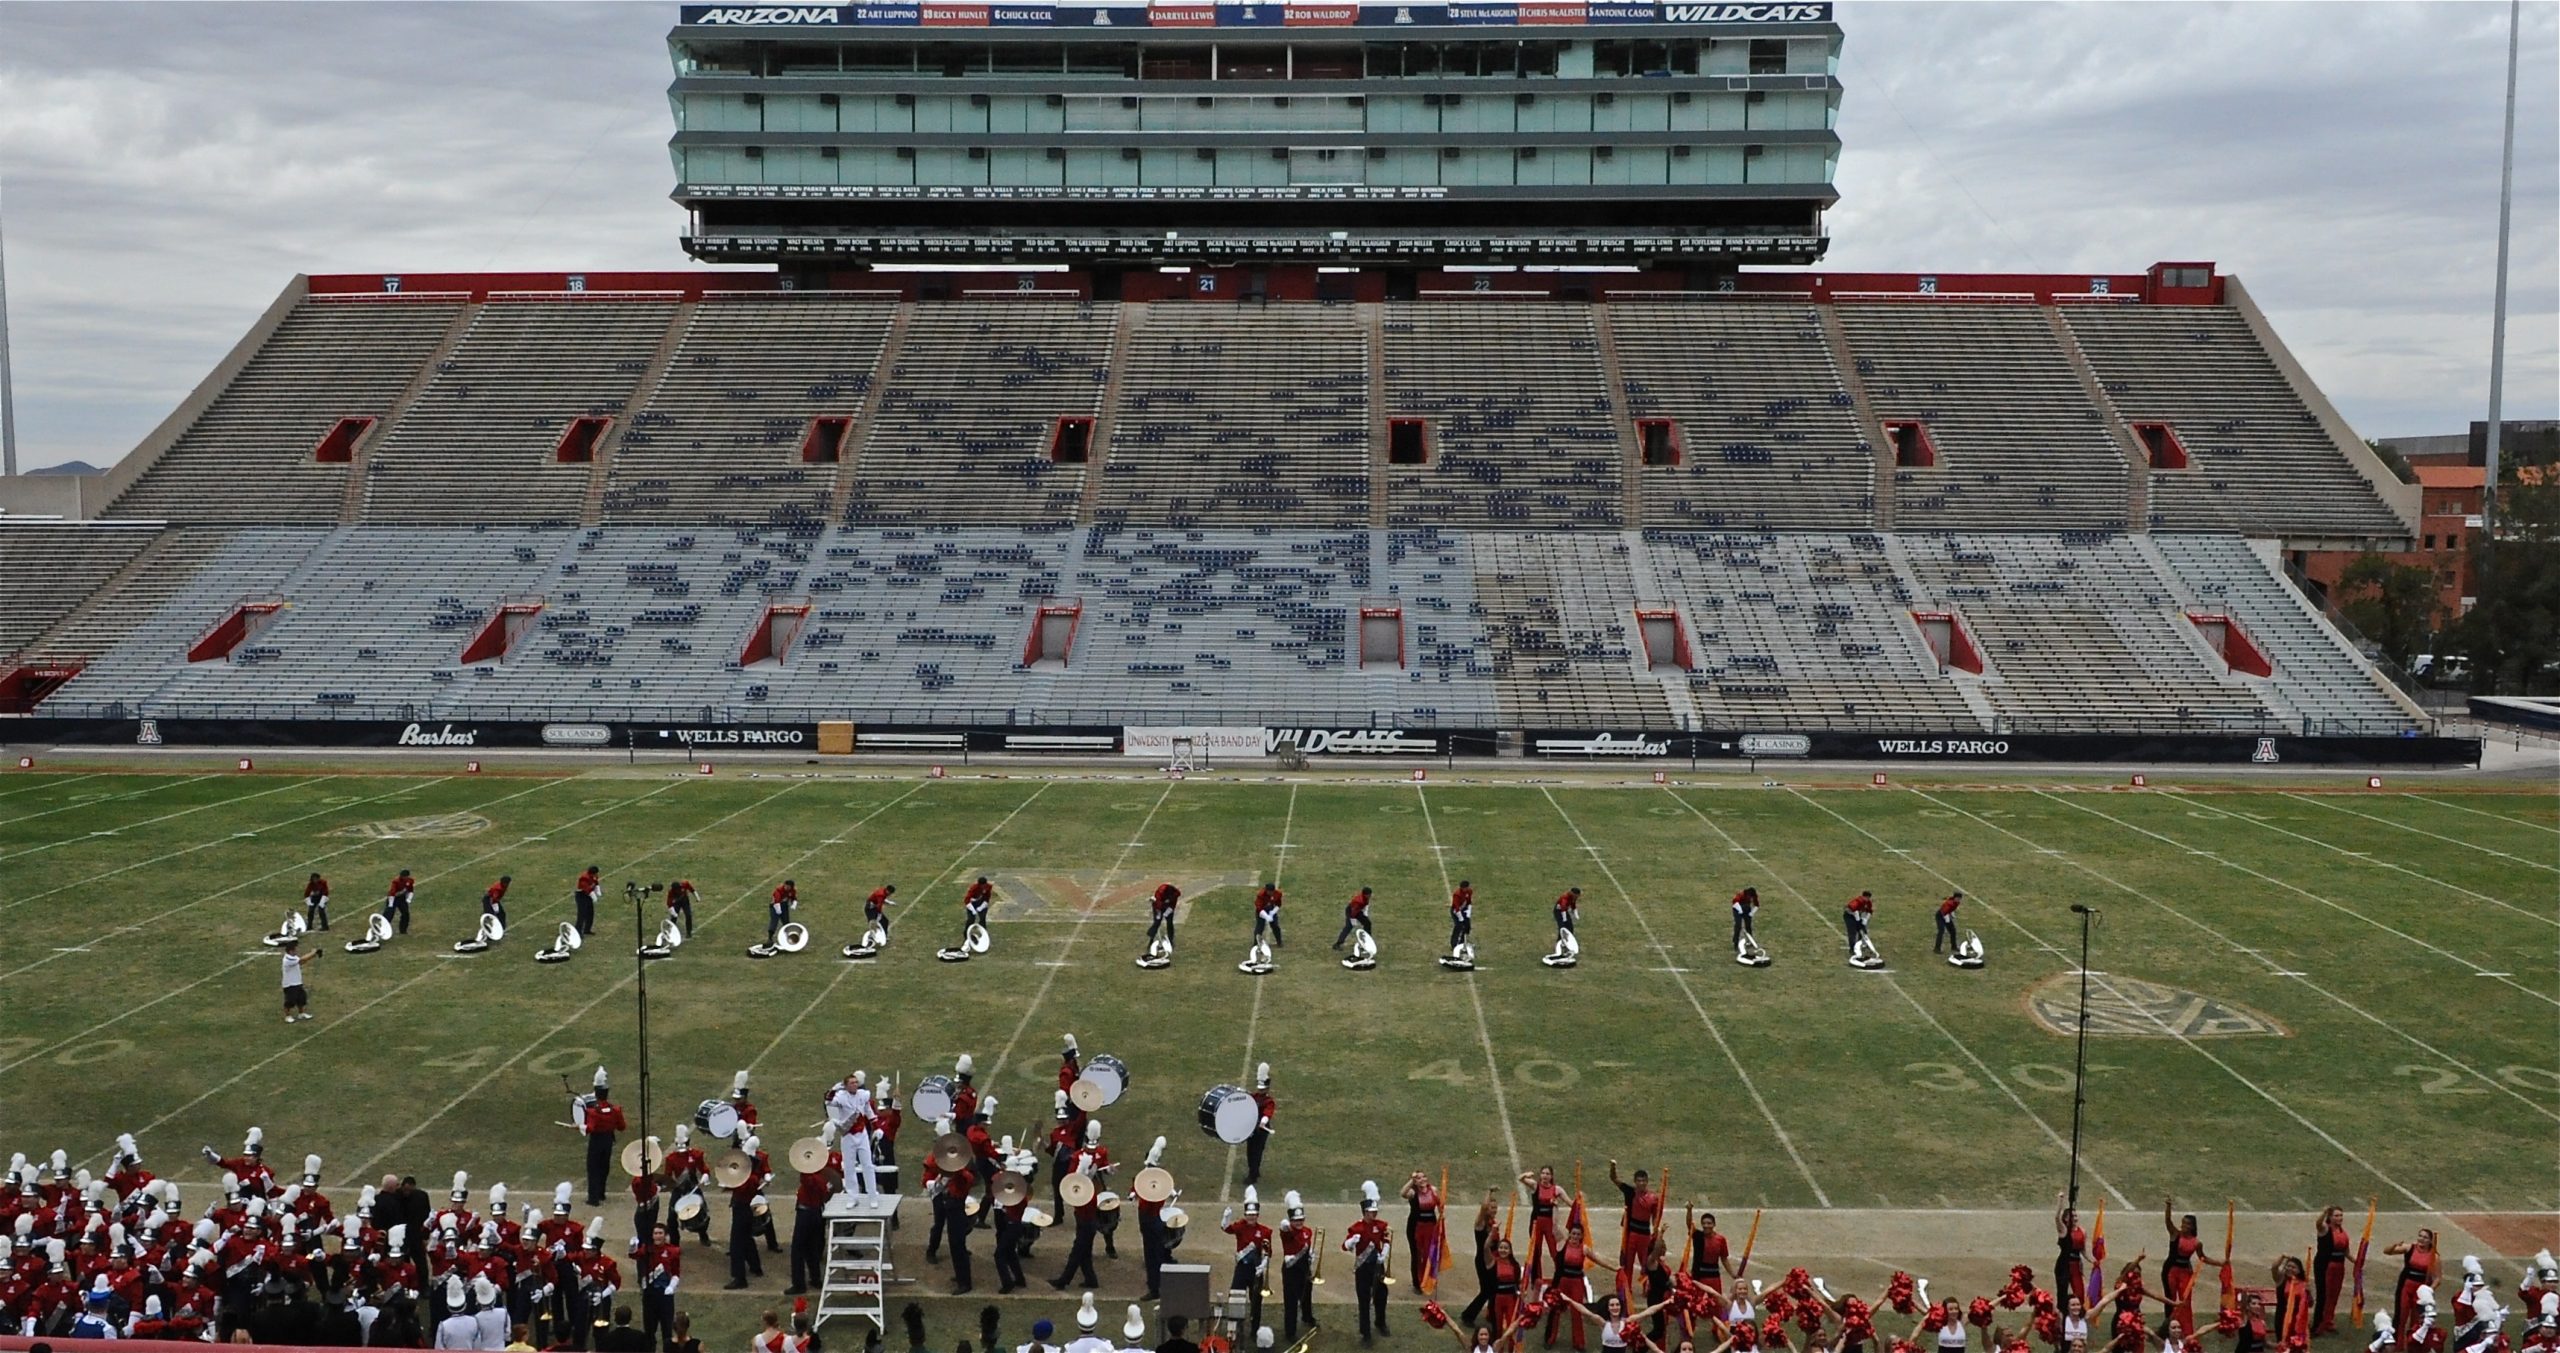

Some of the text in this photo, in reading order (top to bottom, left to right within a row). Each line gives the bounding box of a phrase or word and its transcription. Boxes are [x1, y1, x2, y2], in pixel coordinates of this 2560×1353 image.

[697, 8, 838, 25] ARIZONA
[857, 9, 917, 19] 22 ART LUPPINO
[933, 10, 956, 19] RICKY
[958, 10, 988, 19] HUNLEY
[1000, 10, 1029, 20] CHUCK
[1030, 11, 1052, 20] CECIL
[1148, 10, 1214, 20] 4 DARRYLL LEWIS
[1295, 10, 1311, 19] ROB
[1313, 10, 1350, 19] WALDROP
[1459, 9, 1477, 18] STEVE
[1478, 9, 1517, 18] McLAUGHLIN
[1526, 8, 1548, 17] CHRIS
[1548, 8, 1586, 17] McALISTER
[1593, 9, 1627, 17] ANTOINE
[1627, 8, 1654, 17] CASON
[1665, 5, 1823, 22] WILDCATS
[386, 283, 398, 293] 17
[569, 281, 583, 291] 18
[780, 281, 793, 291] 19
[1019, 280, 1034, 290] 20
[1200, 280, 1213, 290] 21
[1474, 281, 1489, 290] 22
[1720, 281, 1734, 291] 23
[1920, 283, 1935, 292] 24
[2092, 284, 2107, 294] 25
[399, 723, 477, 745] Bashas'
[567, 729, 604, 737] CASINOS
[677, 730, 803, 743] WELLS FARGO
[1128, 736, 1169, 747] UNIVERSITY
[1222, 737, 1243, 747] BAND
[1245, 737, 1262, 747] DAY
[1765, 740, 1804, 748] CASINOS
[1879, 740, 2008, 754] WELLS FARGO
[858, 1276, 875, 1294] 50
